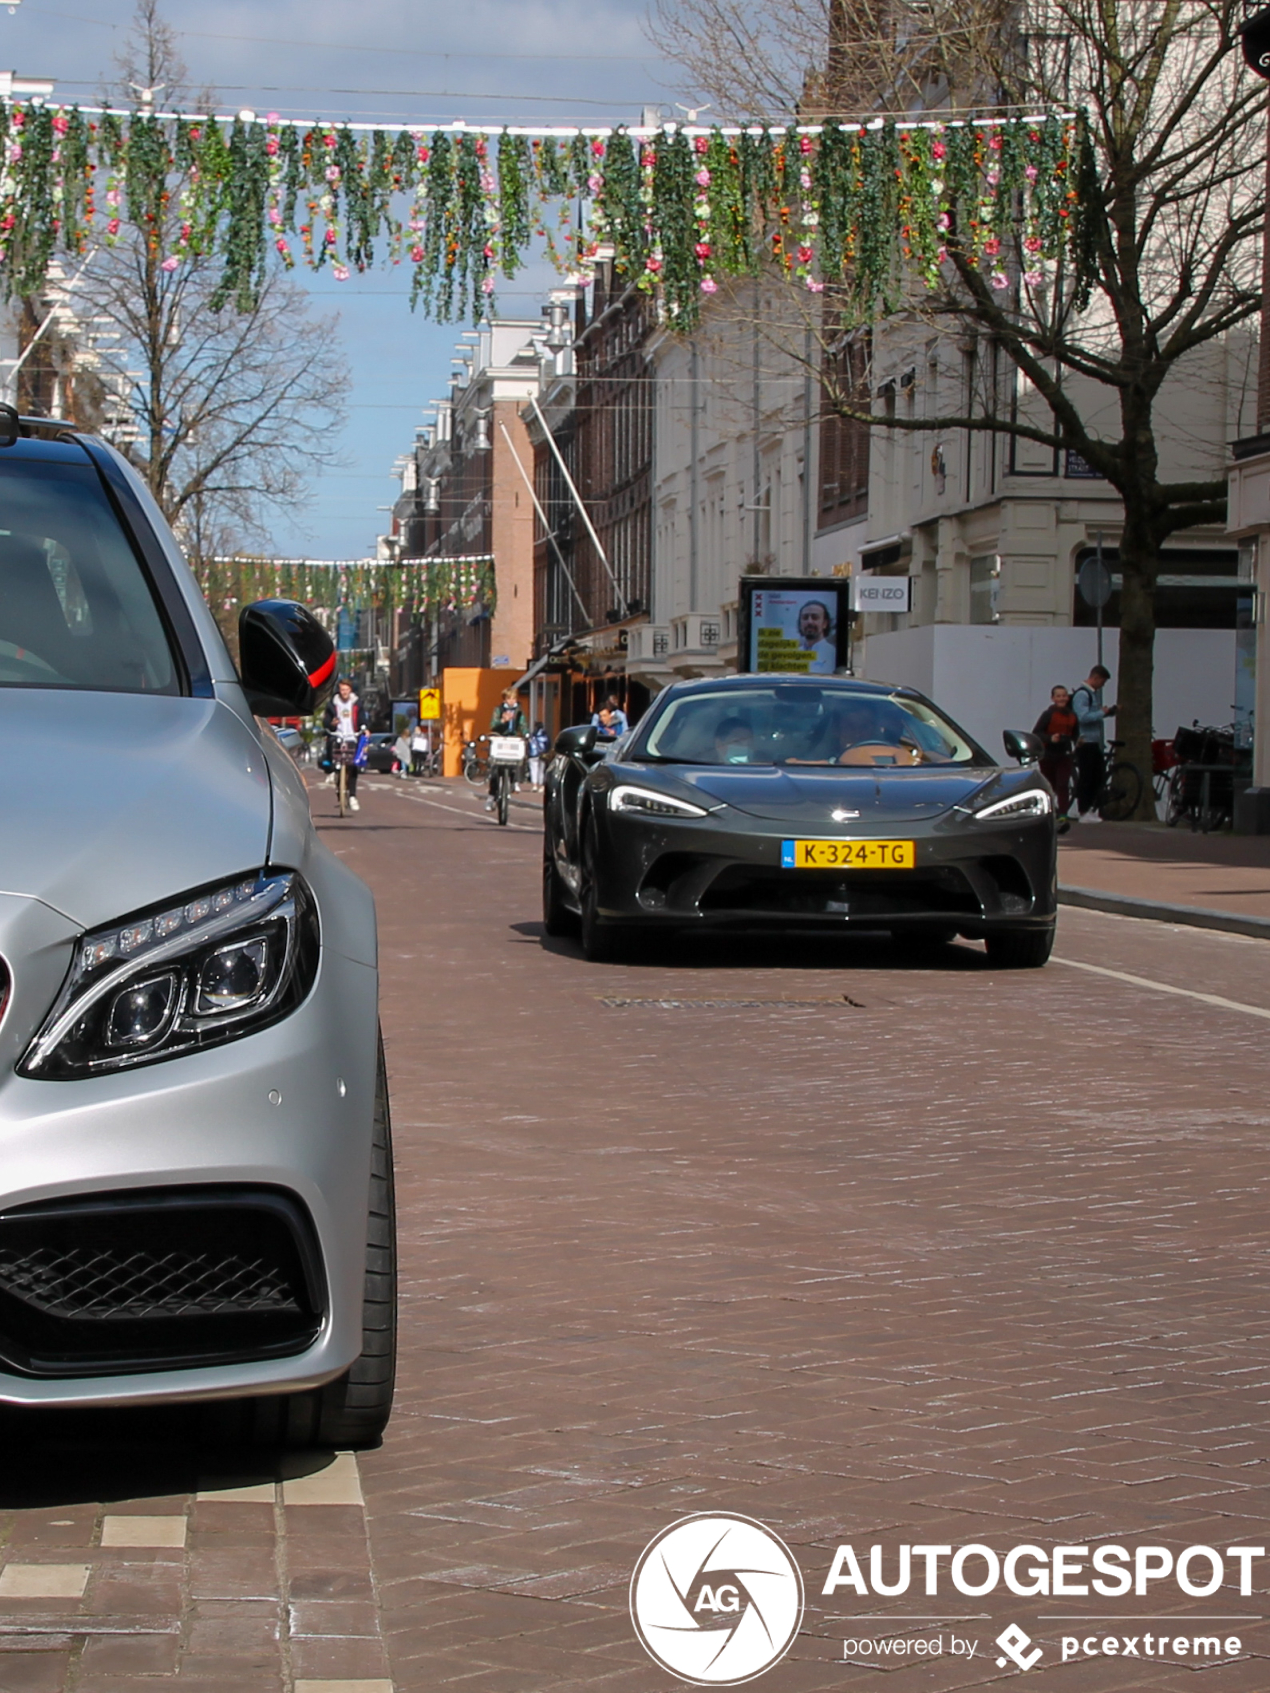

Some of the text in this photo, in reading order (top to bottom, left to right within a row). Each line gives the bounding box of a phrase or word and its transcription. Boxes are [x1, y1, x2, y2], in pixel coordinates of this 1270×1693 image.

[859, 588, 904, 600] KENZO
[758, 651, 769, 659] de
[804, 845, 905, 864] K-324-TG
